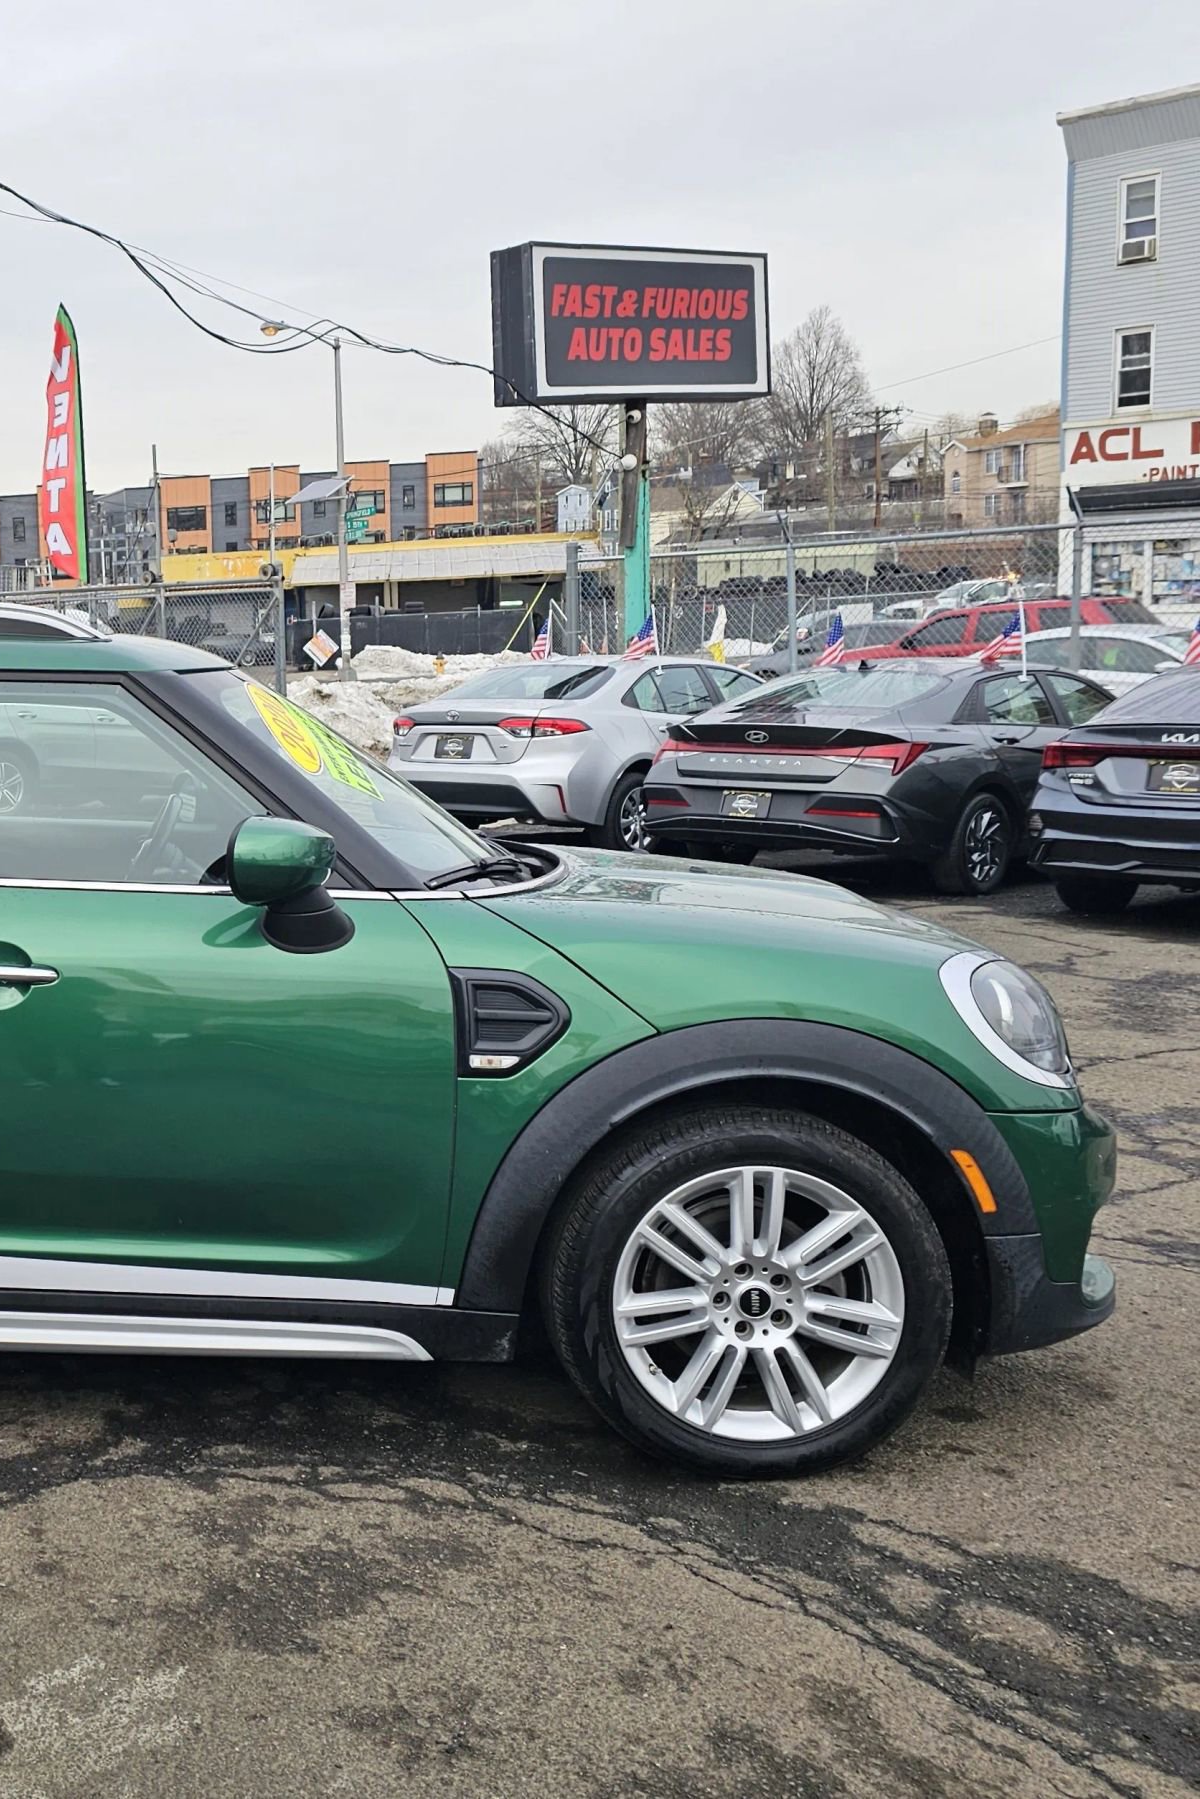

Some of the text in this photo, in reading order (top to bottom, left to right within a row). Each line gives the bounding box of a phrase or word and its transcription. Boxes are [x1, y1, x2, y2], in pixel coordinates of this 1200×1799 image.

[551, 284, 619, 319] FAST
[642, 286, 749, 321] FURIOUS
[567, 327, 732, 362] AUTO SALES
[1069, 426, 1164, 464] ACL
[1161, 732, 1200, 743] KIA
[708, 757, 802, 766] ELANTRA
[750, 1290, 761, 1314] MINI
